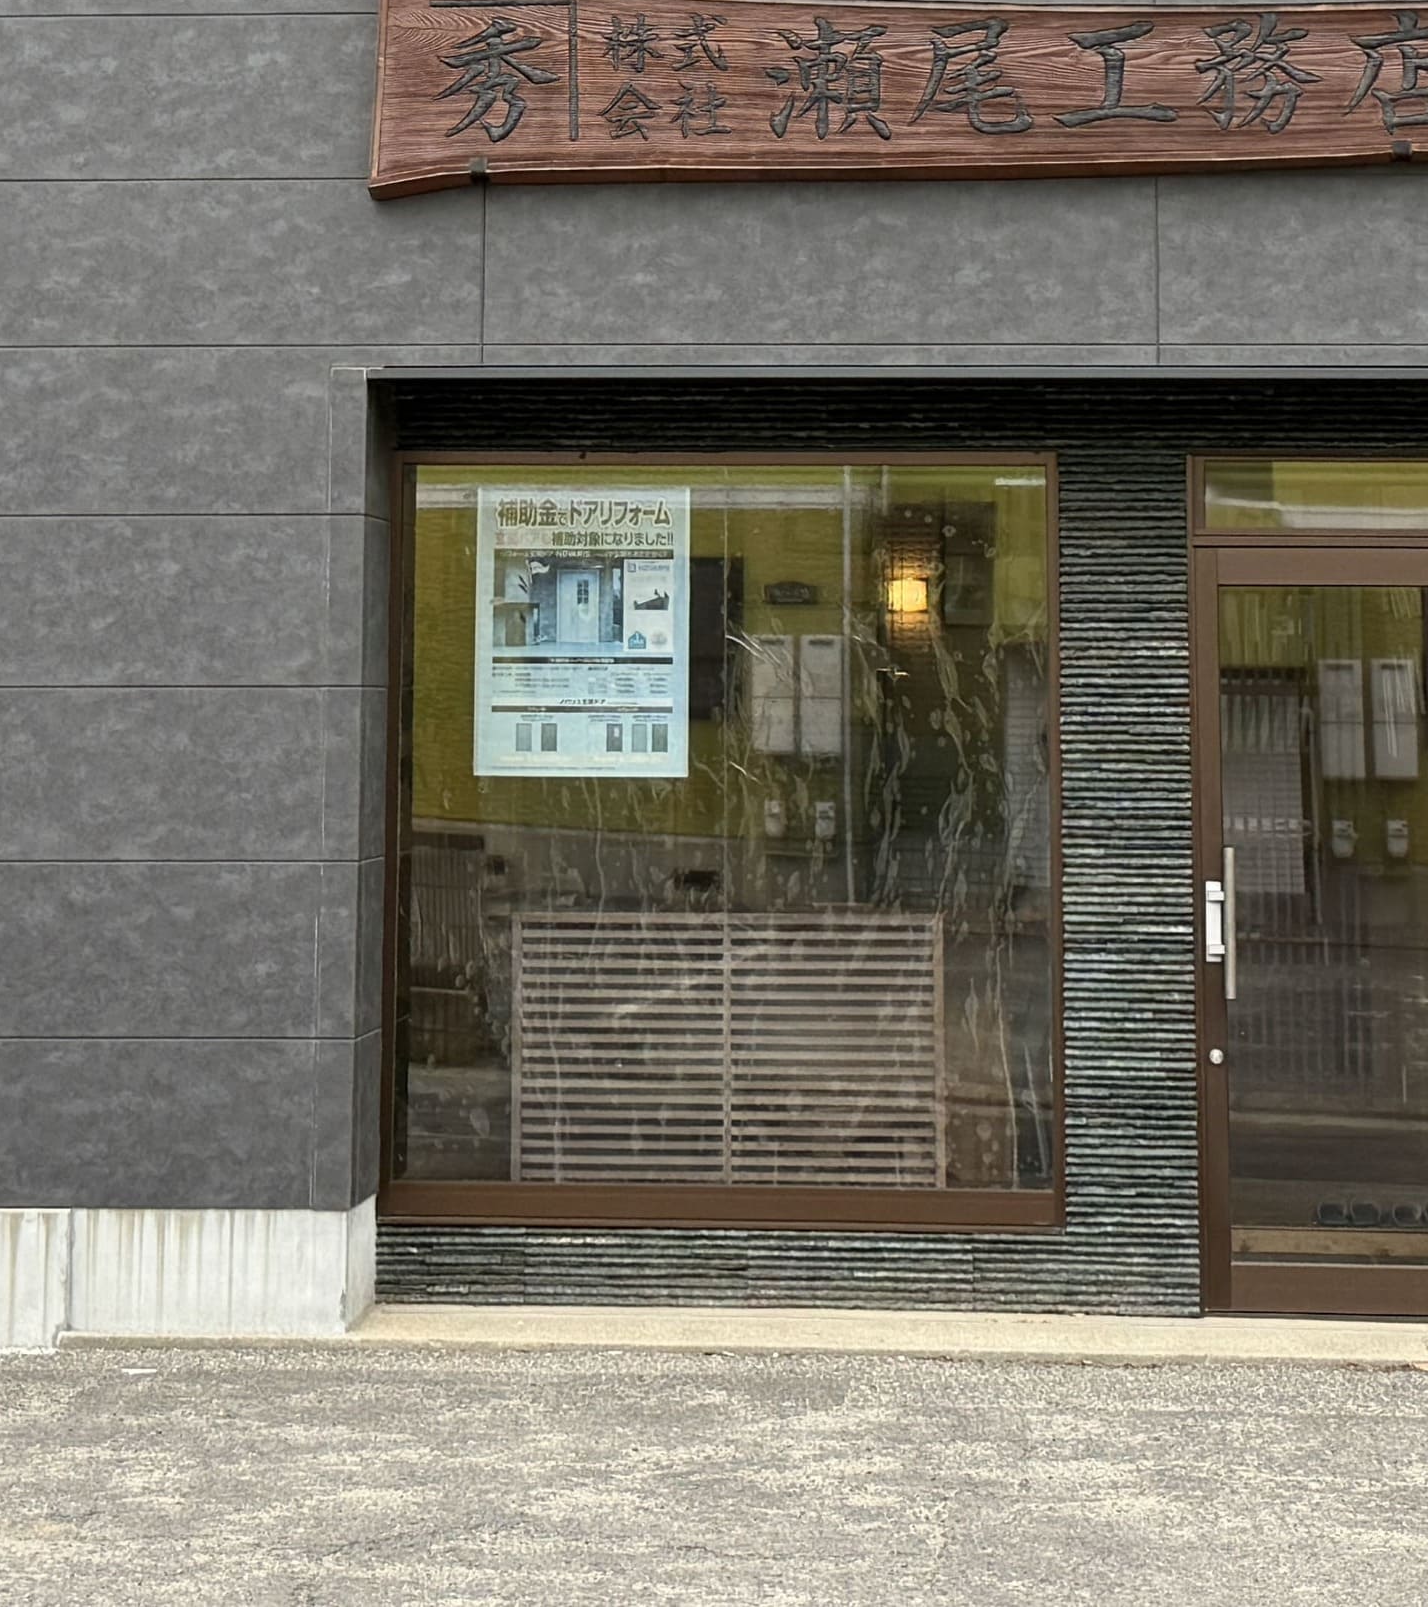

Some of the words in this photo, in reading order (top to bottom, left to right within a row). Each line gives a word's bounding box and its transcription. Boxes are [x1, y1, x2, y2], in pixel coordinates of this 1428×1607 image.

[601, 3, 729, 74] 株式
[432, 7, 561, 143] 秀
[596, 82, 733, 141] 会社
[497, 498, 671, 527] 補助金でドアリフォーム
